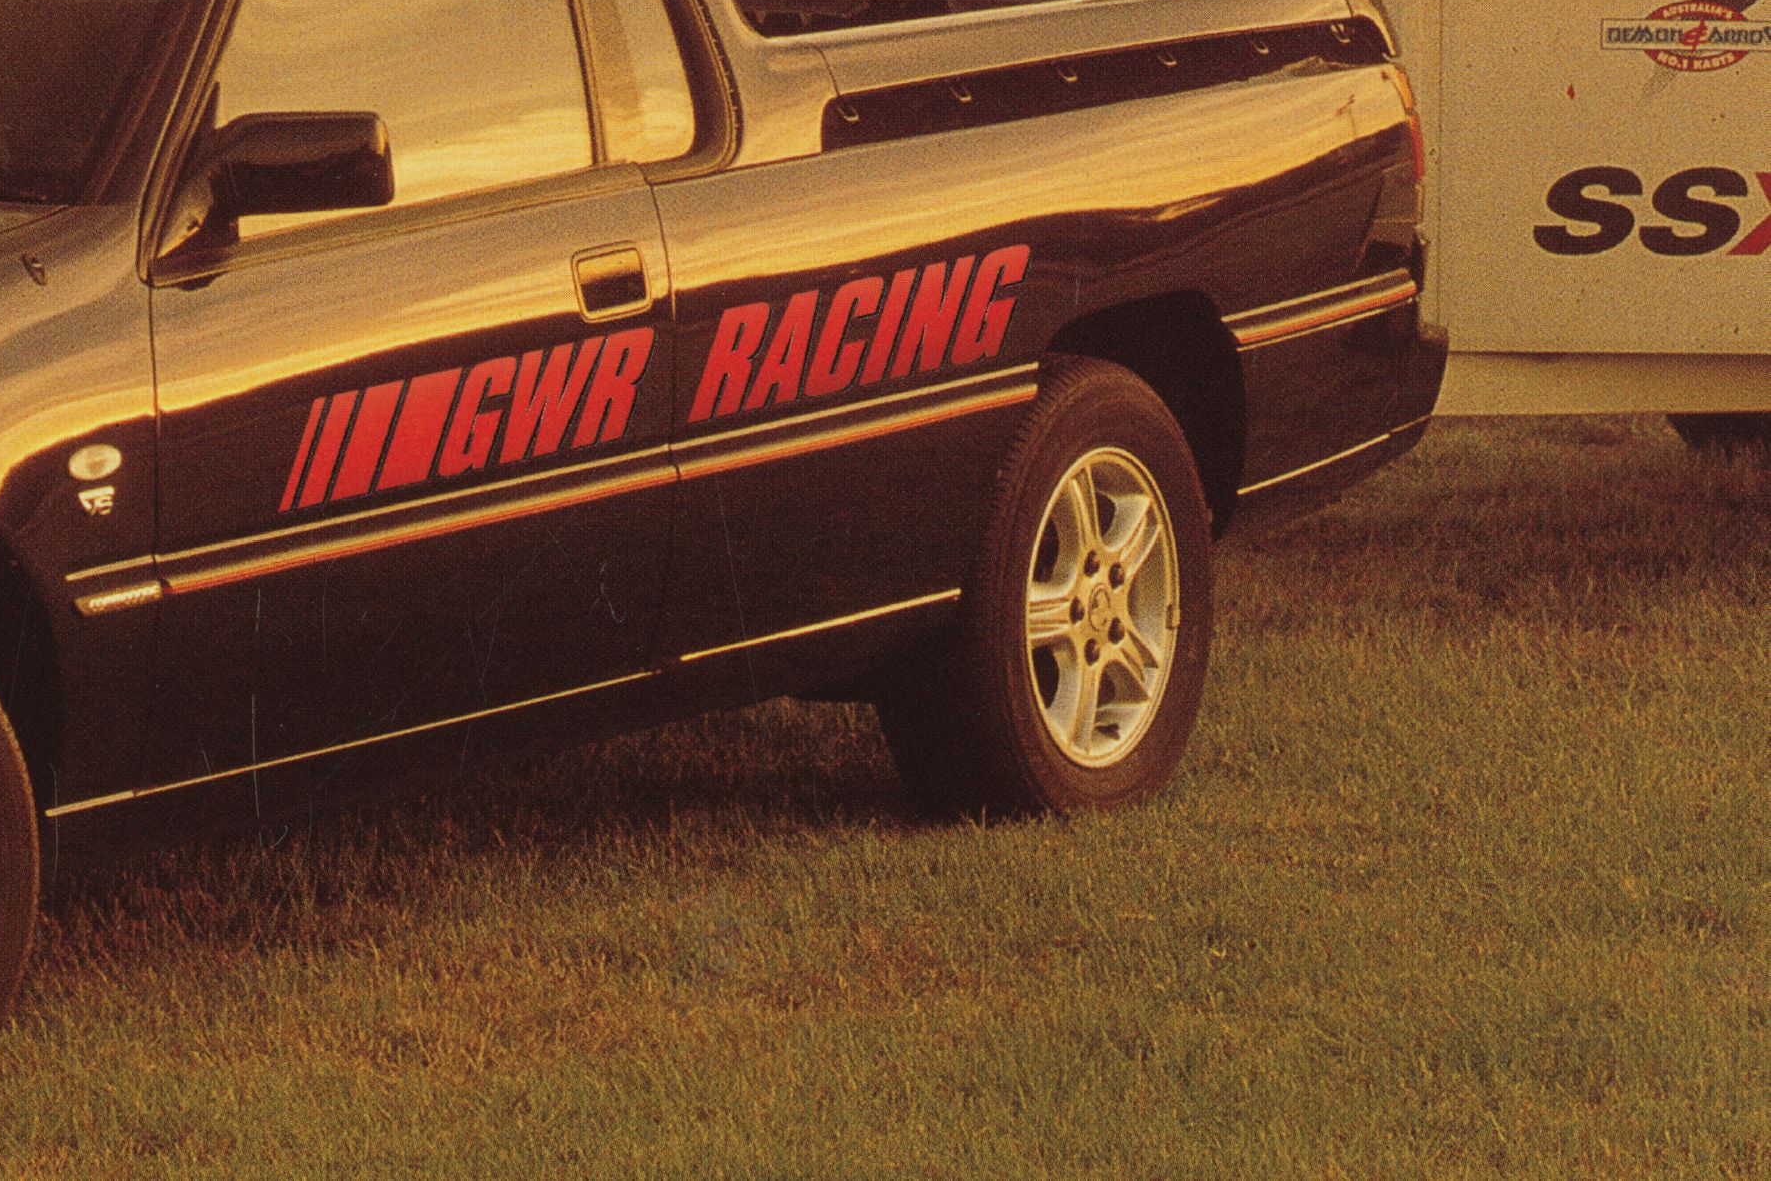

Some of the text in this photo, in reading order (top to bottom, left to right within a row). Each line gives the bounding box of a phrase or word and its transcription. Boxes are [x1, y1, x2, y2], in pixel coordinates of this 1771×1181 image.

[1693, 51, 1735, 69] KARTS
[435, 243, 1032, 474] GWR RACING
